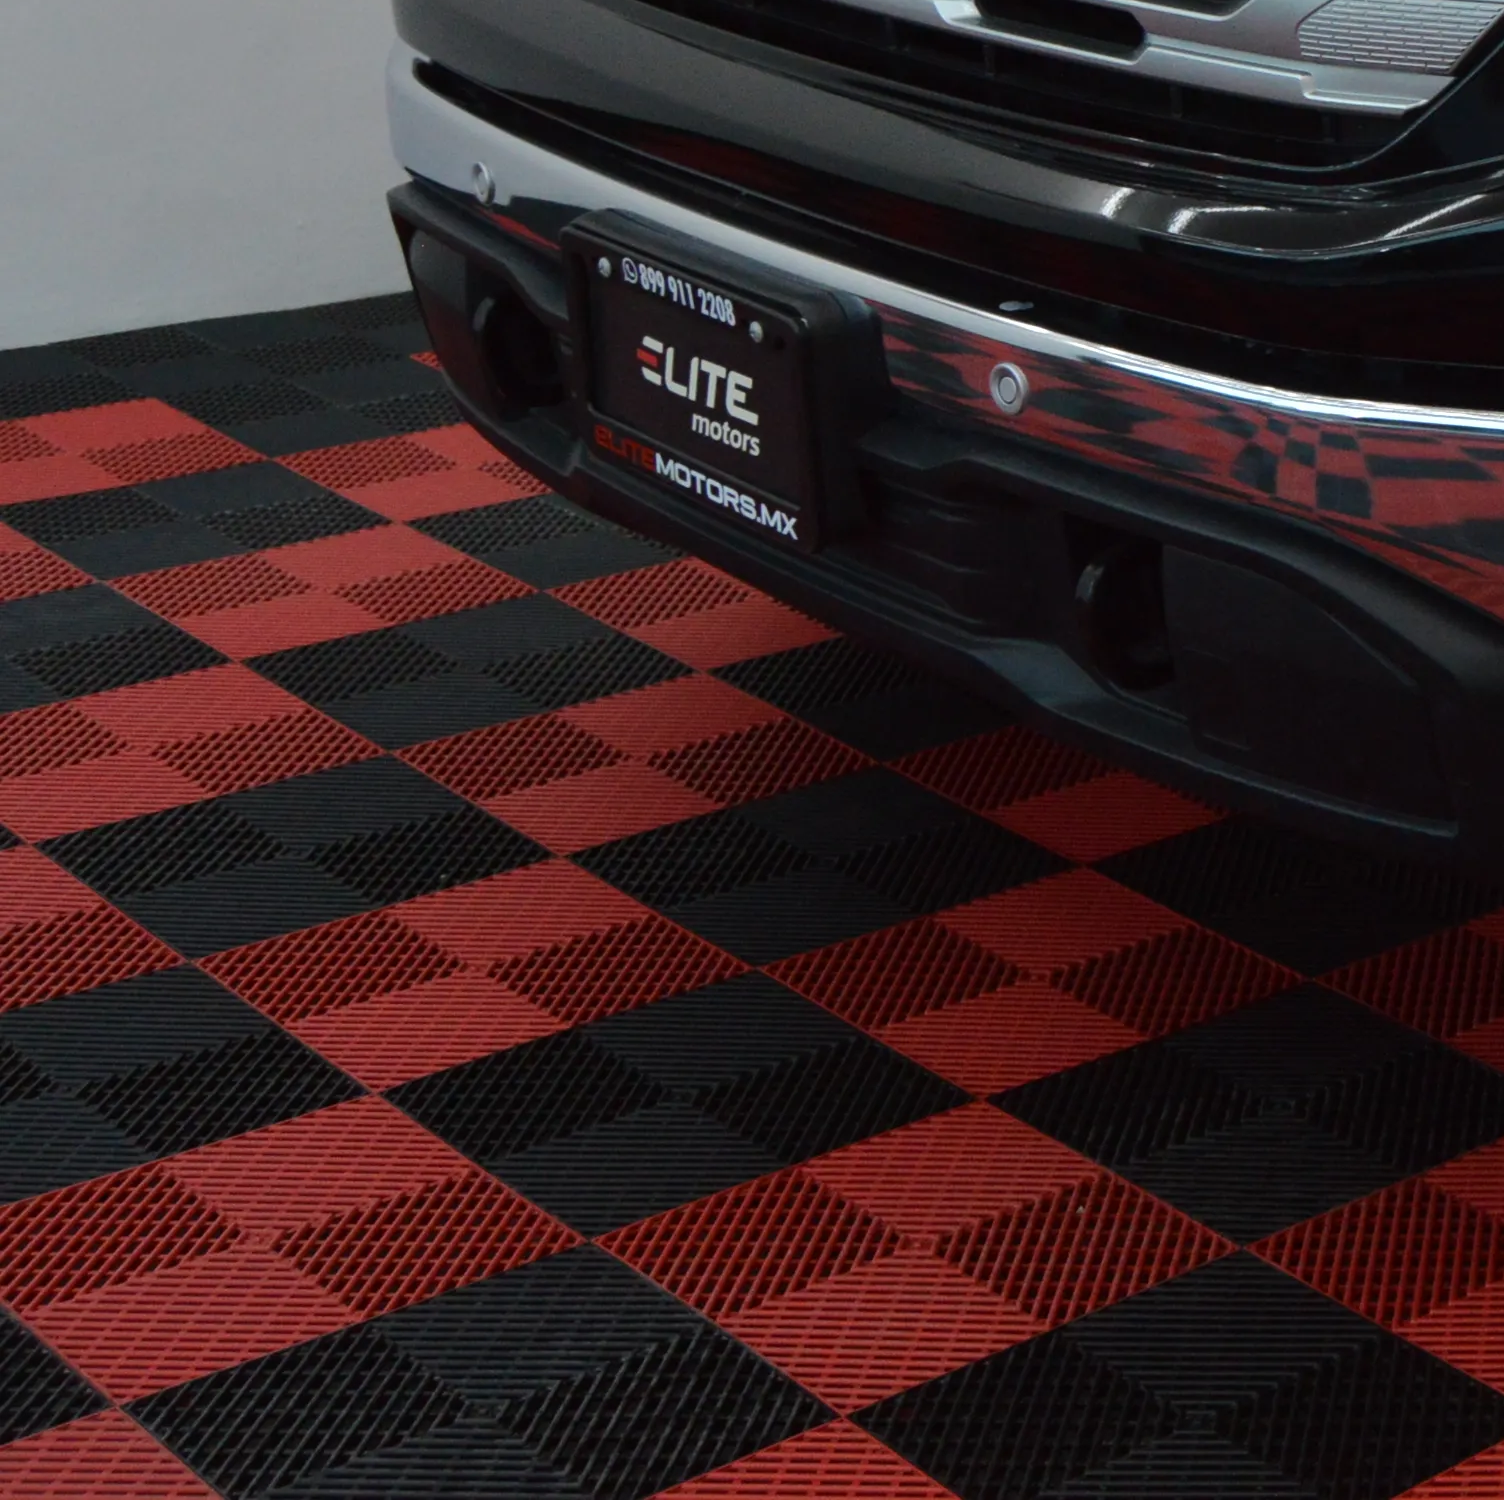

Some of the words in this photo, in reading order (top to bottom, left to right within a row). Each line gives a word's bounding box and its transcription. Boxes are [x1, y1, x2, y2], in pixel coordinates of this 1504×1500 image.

[638, 262, 665, 297] 899
[668, 275, 695, 310] 911
[697, 288, 737, 327] 2208
[636, 335, 759, 426] ELITE
[691, 412, 761, 457] motors
[594, 424, 799, 541] ELITEMOTORS.MX
